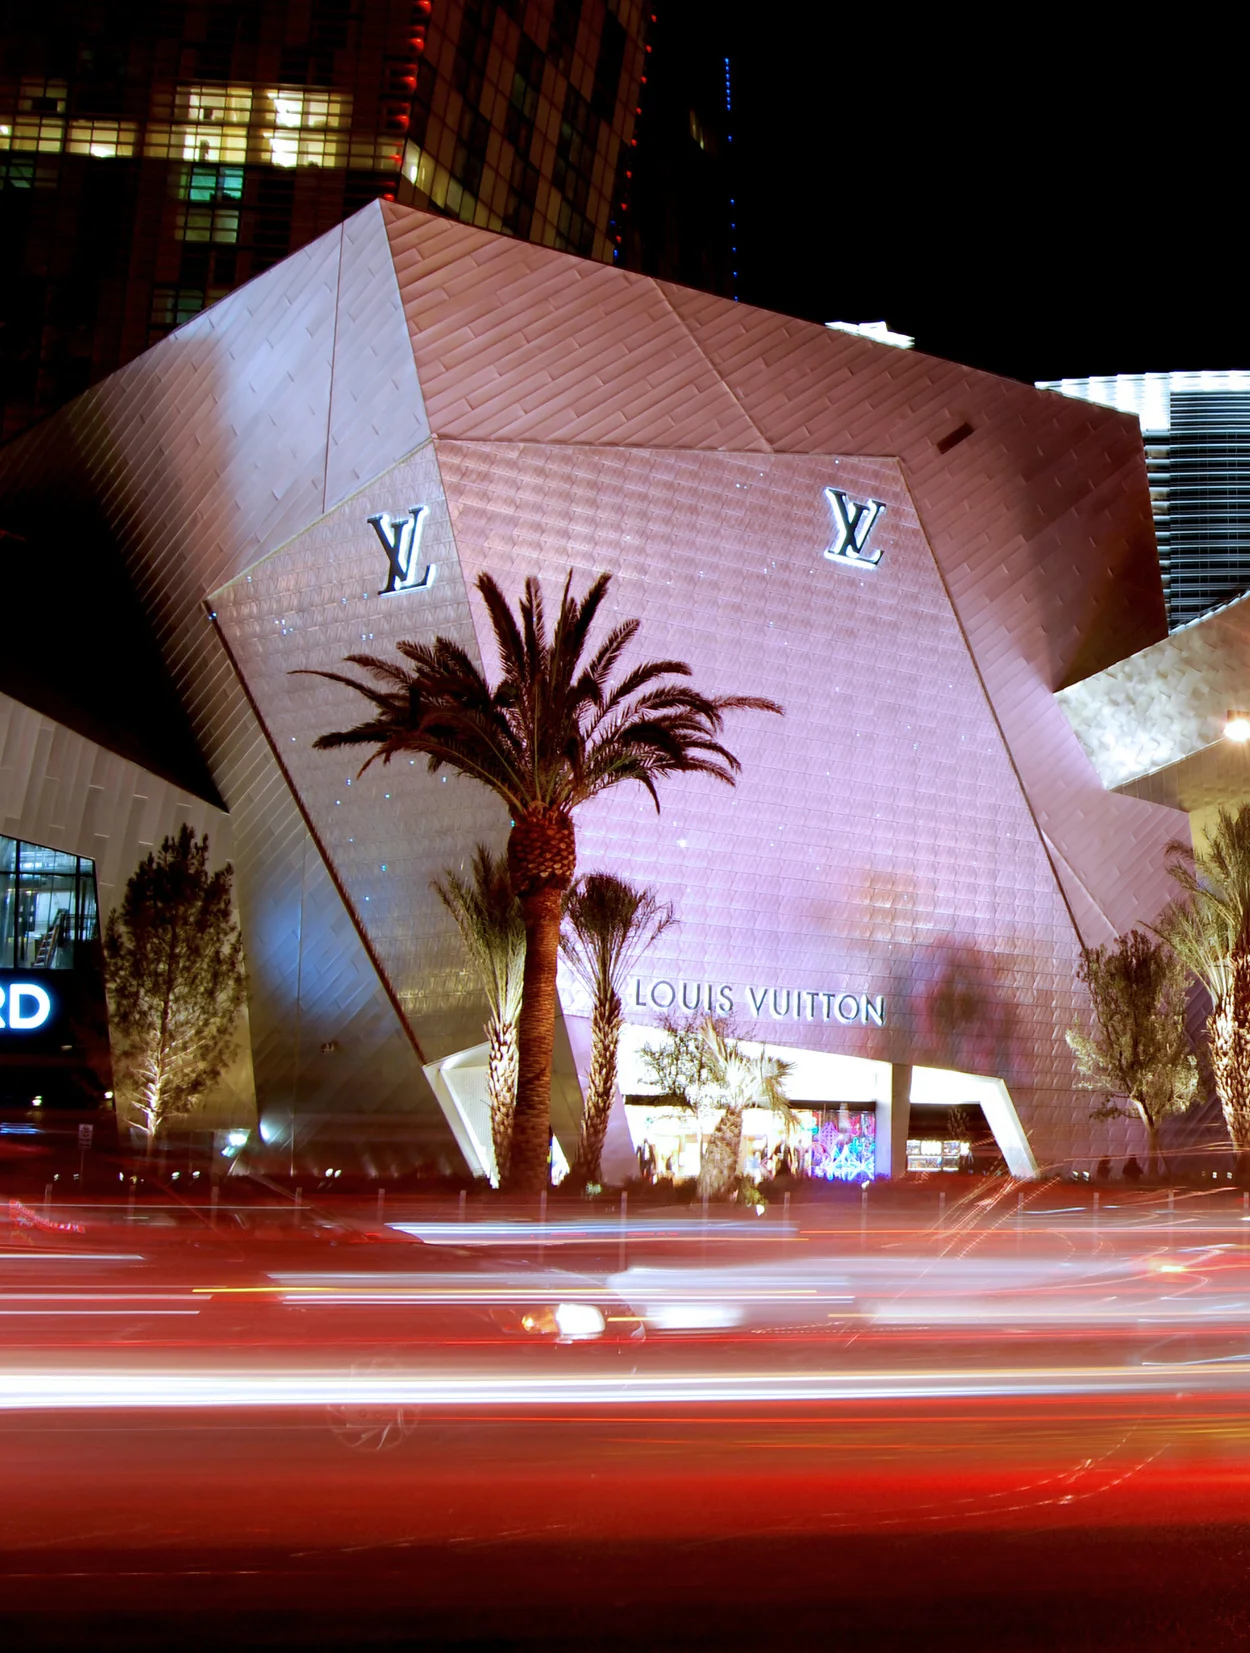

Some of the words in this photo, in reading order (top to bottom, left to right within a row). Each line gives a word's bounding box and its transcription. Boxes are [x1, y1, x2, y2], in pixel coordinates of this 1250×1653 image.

[0, 983, 51, 1029] D
[634, 978, 734, 1013] LOUIS
[748, 986, 886, 1025] VUITTON
